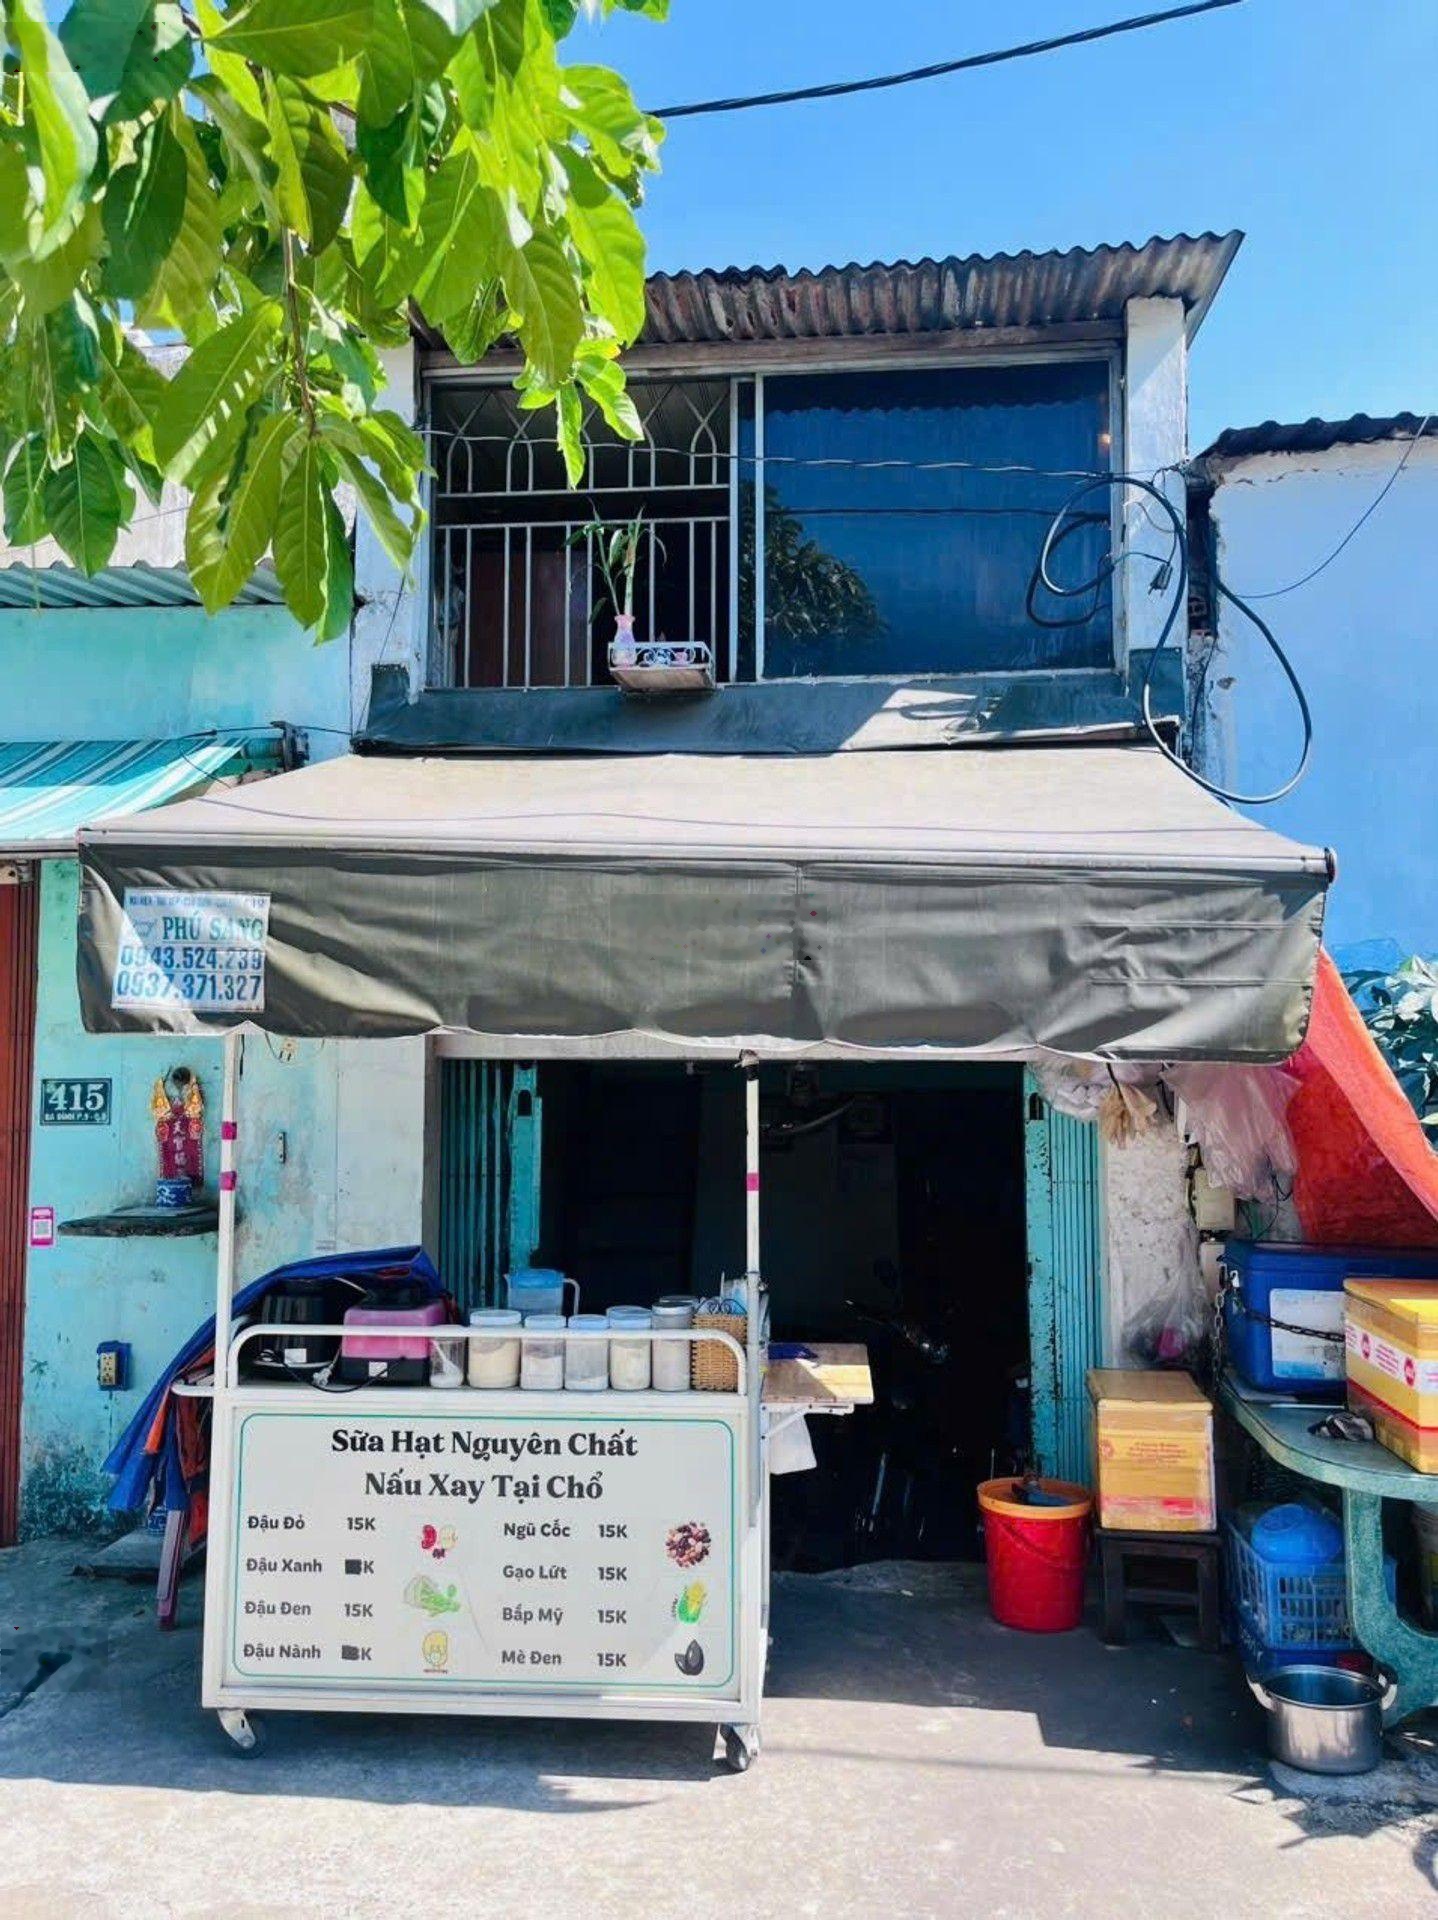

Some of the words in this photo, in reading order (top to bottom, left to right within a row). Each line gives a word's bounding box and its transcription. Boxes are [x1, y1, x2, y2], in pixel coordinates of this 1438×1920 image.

[162, 911, 200, 940] PHÚ
[117, 971, 261, 1000] 0937.371.327
[48, 1083, 104, 1110] 415
[332, 1429, 384, 1452] Sữa
[391, 1431, 445, 1459] Hạt
[452, 1431, 561, 1461] Nguyên
[568, 1429, 637, 1456] Chất
[365, 1468, 422, 1496] Nấu
[429, 1474, 484, 1504] Xay
[491, 1474, 540, 1504] Tại
[546, 1471, 604, 1499] Chổ
[247, 1515, 278, 1532] Đậu
[283, 1514, 305, 1529] Đỏ
[347, 1517, 376, 1530] 15K
[503, 1522, 536, 1540] Ngũ
[540, 1519, 571, 1537] Cốc
[598, 1524, 628, 1538] 15K
[246, 1557, 277, 1575] Đậu
[281, 1558, 322, 1573] Xanh
[502, 1565, 534, 1582] Gạo
[538, 1564, 567, 1579] Lứt
[597, 1566, 628, 1581] 15K
[244, 1600, 276, 1618] Đậu
[280, 1601, 312, 1615] Đen
[344, 1603, 373, 1617] 15K
[538, 1607, 564, 1626] Mỹ
[598, 1609, 627, 1624] 15K
[243, 1643, 275, 1660] Đậu
[279, 1644, 321, 1659] Nành
[501, 1649, 526, 1665] Mè
[530, 1650, 562, 1665] Đen
[597, 1652, 627, 1667] 15K
